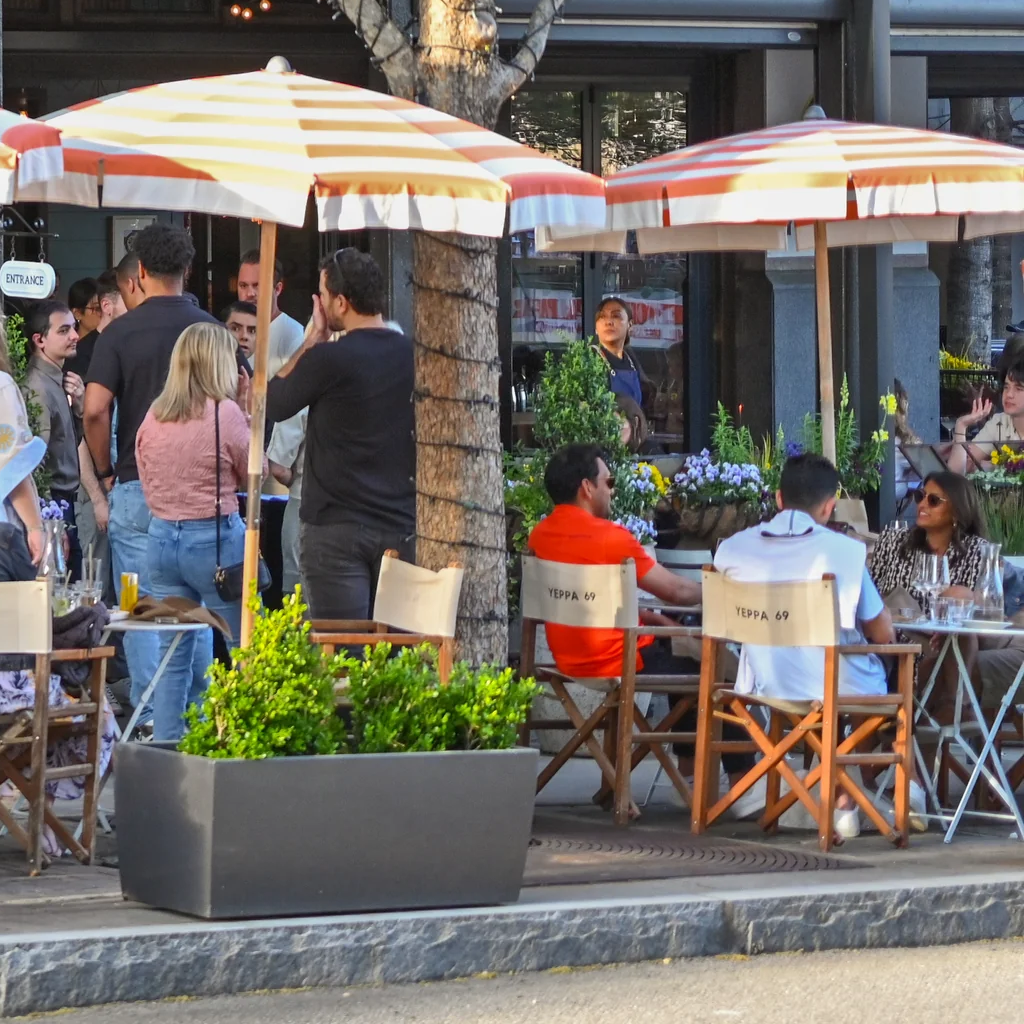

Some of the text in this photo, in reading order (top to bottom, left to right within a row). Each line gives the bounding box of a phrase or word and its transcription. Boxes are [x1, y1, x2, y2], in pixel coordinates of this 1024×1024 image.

[6, 273, 44, 286] ENTRANCE
[548, 587, 596, 601] YEPPA 69
[735, 605, 789, 621] YEPPA 69
